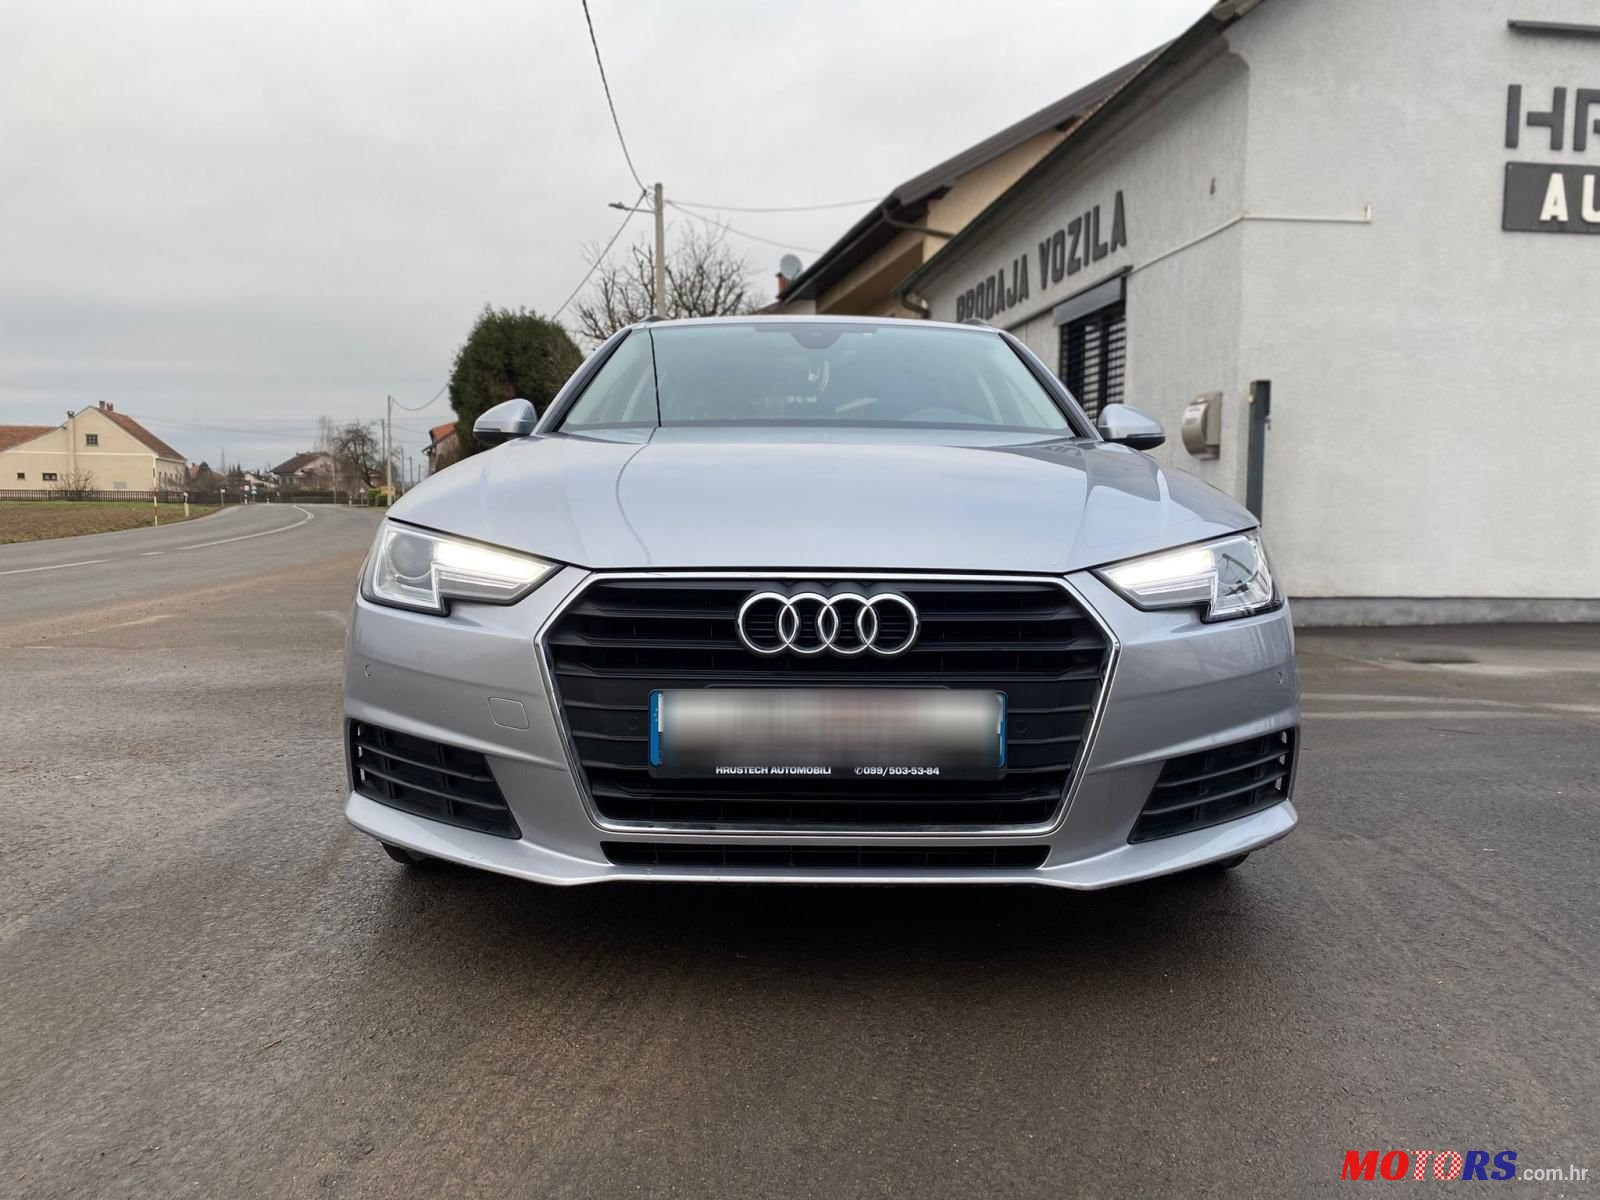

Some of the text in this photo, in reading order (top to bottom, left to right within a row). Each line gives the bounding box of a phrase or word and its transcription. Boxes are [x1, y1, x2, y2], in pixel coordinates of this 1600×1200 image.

[1539, 172, 1600, 223] AU
[956, 190, 1127, 323] PRODAJA VOZILA
[715, 765, 769, 775] HRUSTECH
[770, 765, 832, 775] AUTOMOBILI
